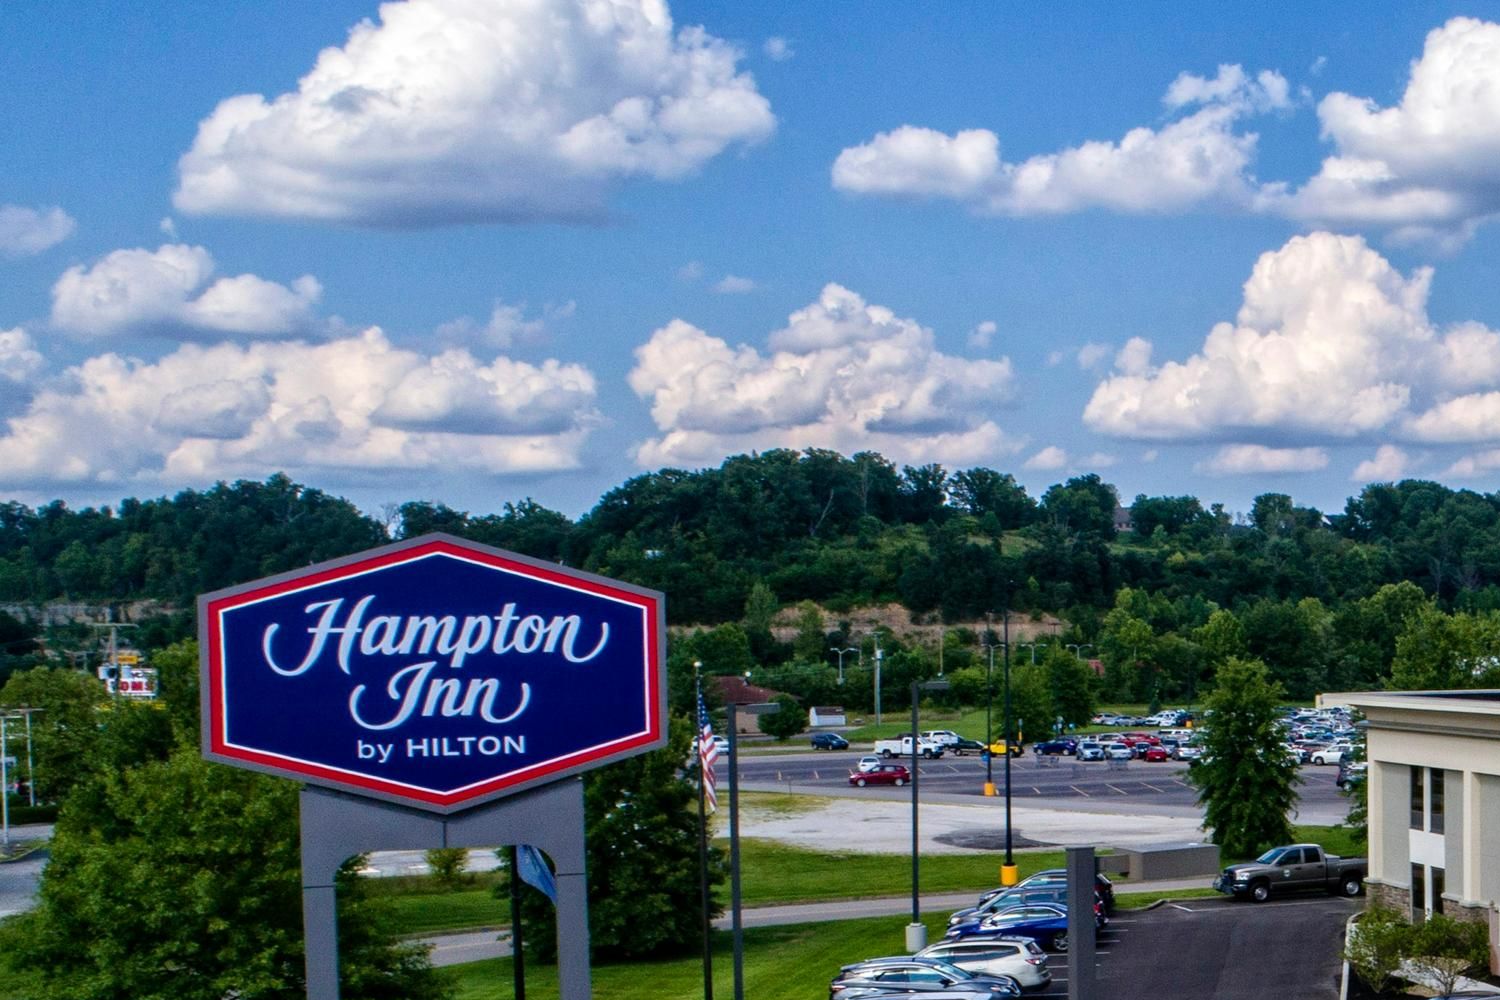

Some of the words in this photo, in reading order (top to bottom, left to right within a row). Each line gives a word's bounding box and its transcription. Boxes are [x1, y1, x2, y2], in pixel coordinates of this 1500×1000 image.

[262, 594, 609, 677] Hampton
[349, 661, 531, 731] Inn
[357, 739, 393, 763] by
[406, 735, 526, 758] HILTON
